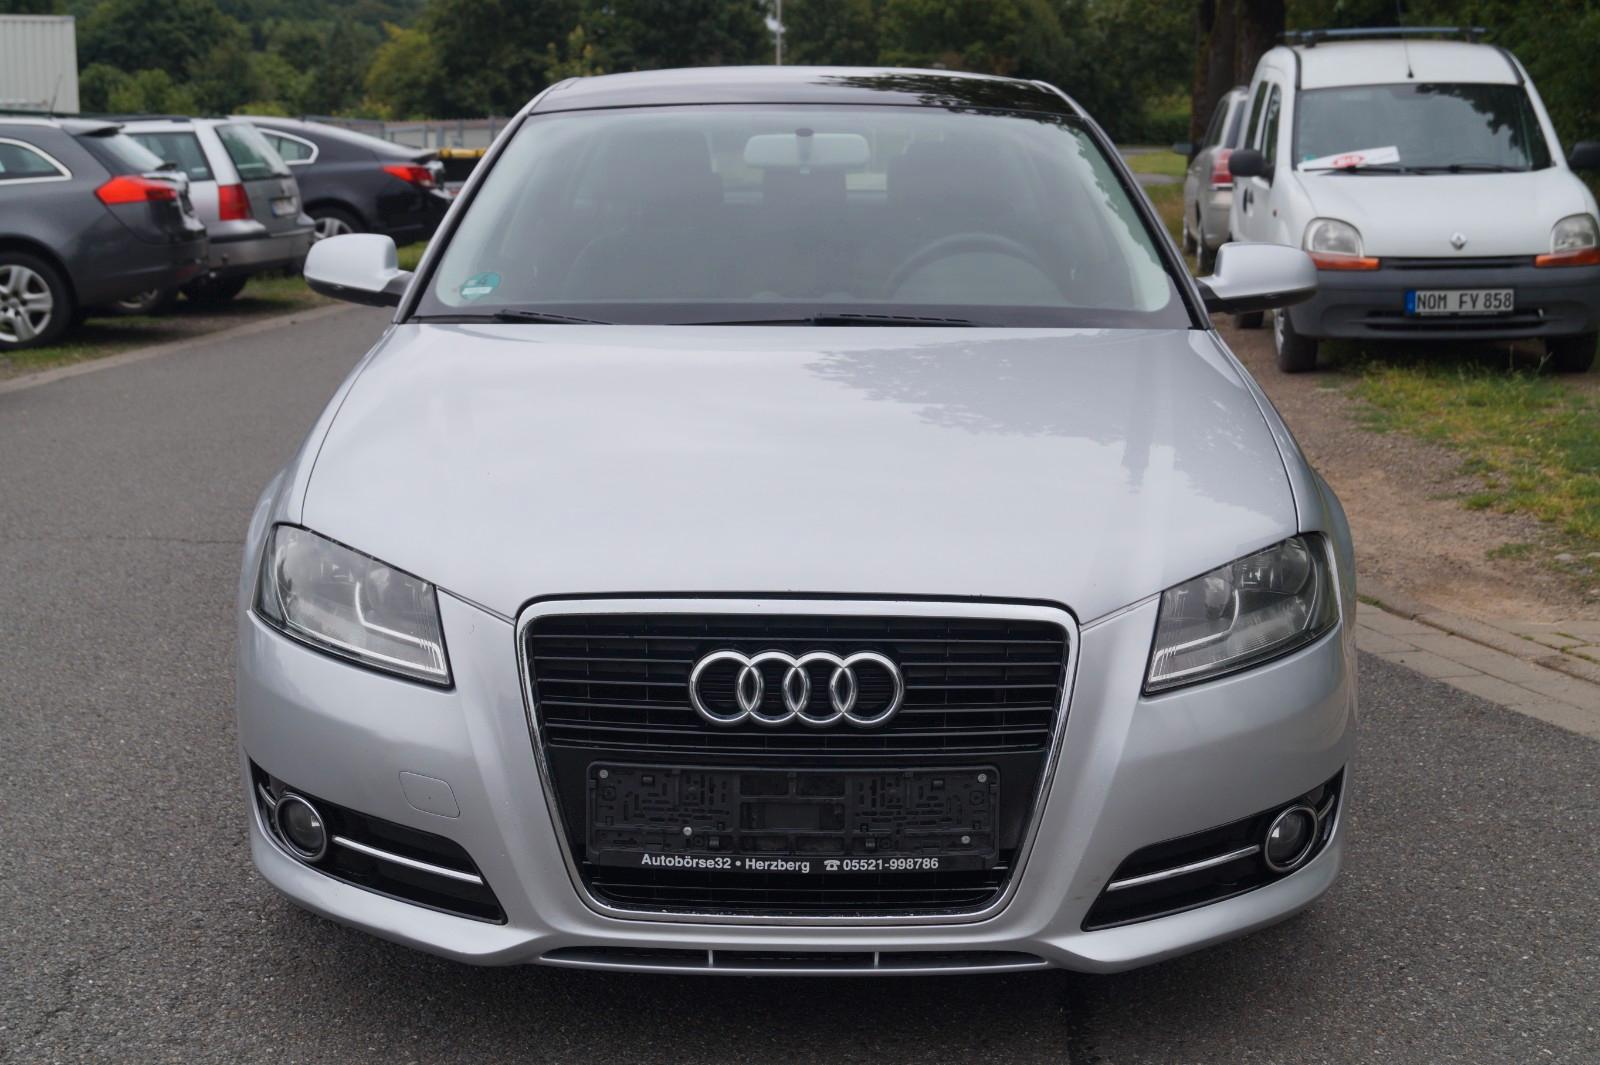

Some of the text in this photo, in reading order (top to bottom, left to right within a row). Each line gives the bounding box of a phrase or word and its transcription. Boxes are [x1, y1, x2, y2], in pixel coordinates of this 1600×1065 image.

[1417, 292, 1512, 310] NOM FY 858
[641, 854, 939, 873] Autobörse32 Herzberg 05521-998786
